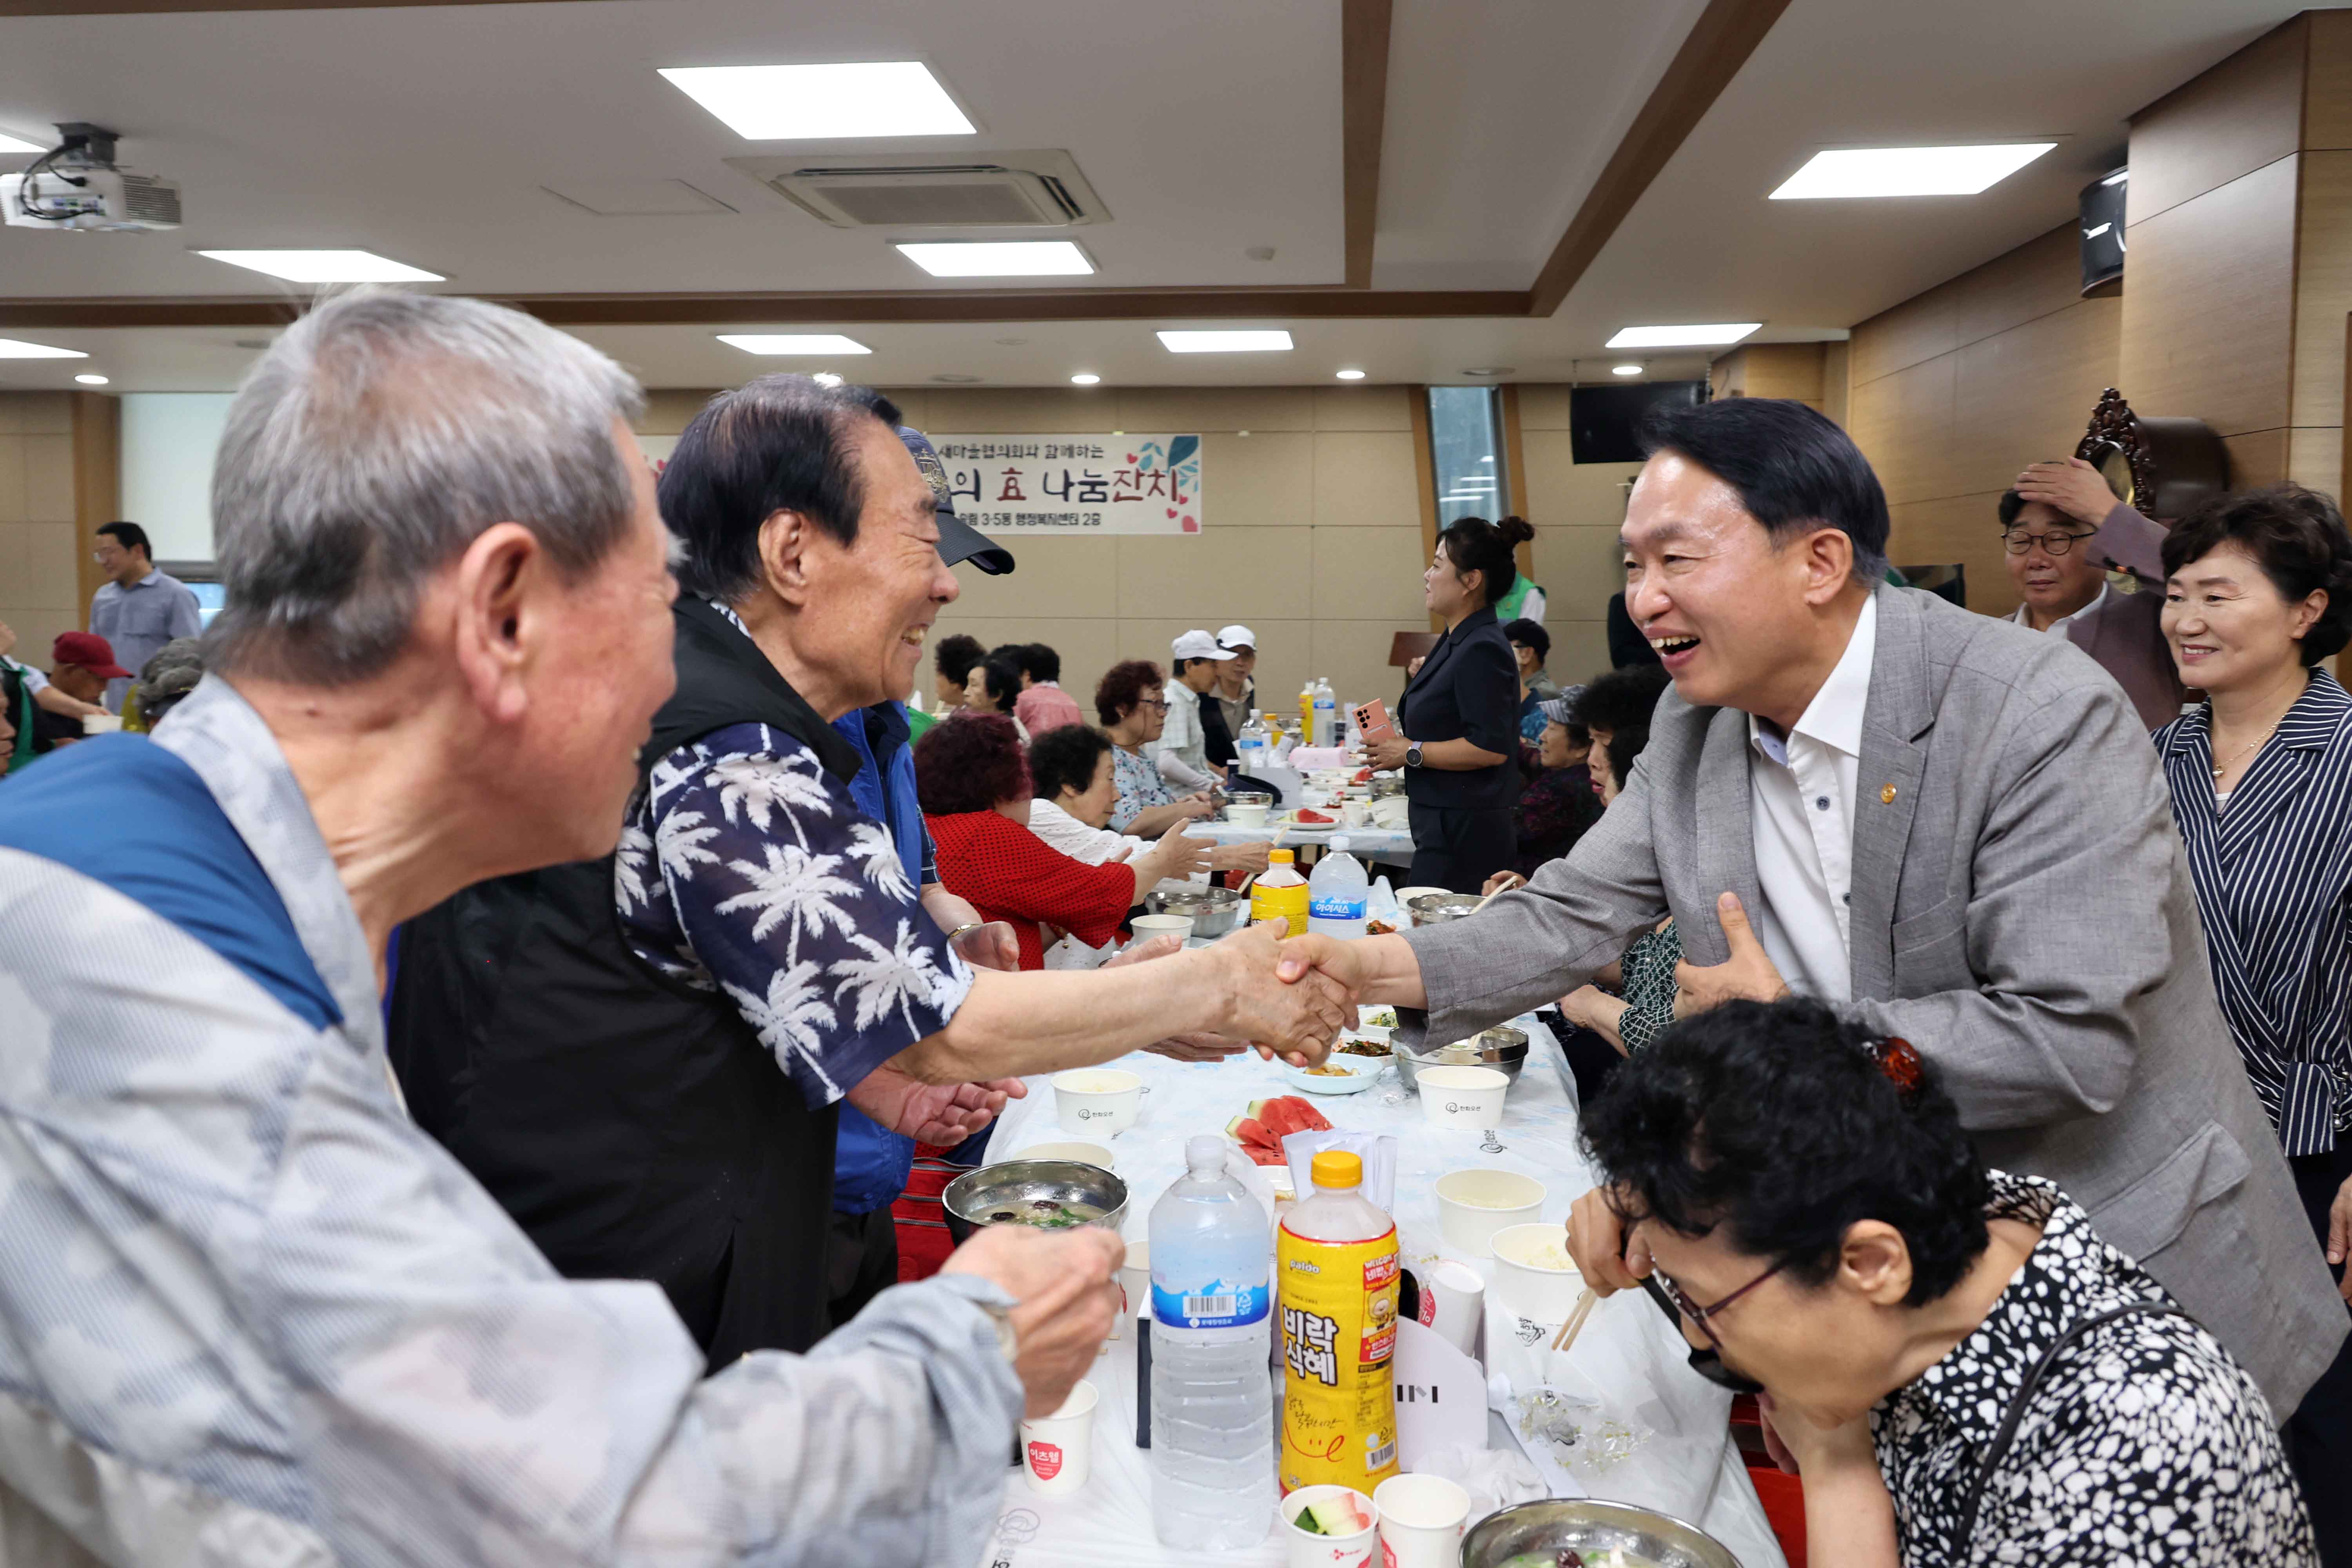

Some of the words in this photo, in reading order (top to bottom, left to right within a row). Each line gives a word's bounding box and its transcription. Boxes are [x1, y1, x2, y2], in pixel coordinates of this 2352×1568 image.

[939, 443, 1039, 459] 새마을협의회와
[1045, 444, 1105, 459] 함께하는
[951, 468, 981, 502] 의
[997, 467, 1027, 501] 효
[1016, 512, 1079, 526] 행정복지센터
[1083, 513, 1101, 526] 2층
[1316, 903, 1350, 913] 아이시스
[1290, 1259, 1320, 1274] paldo
[1283, 1304, 1339, 1353] 비락
[1287, 1336, 1338, 1386] 식혜
[1030, 1449, 1059, 1464] 이츠웰
